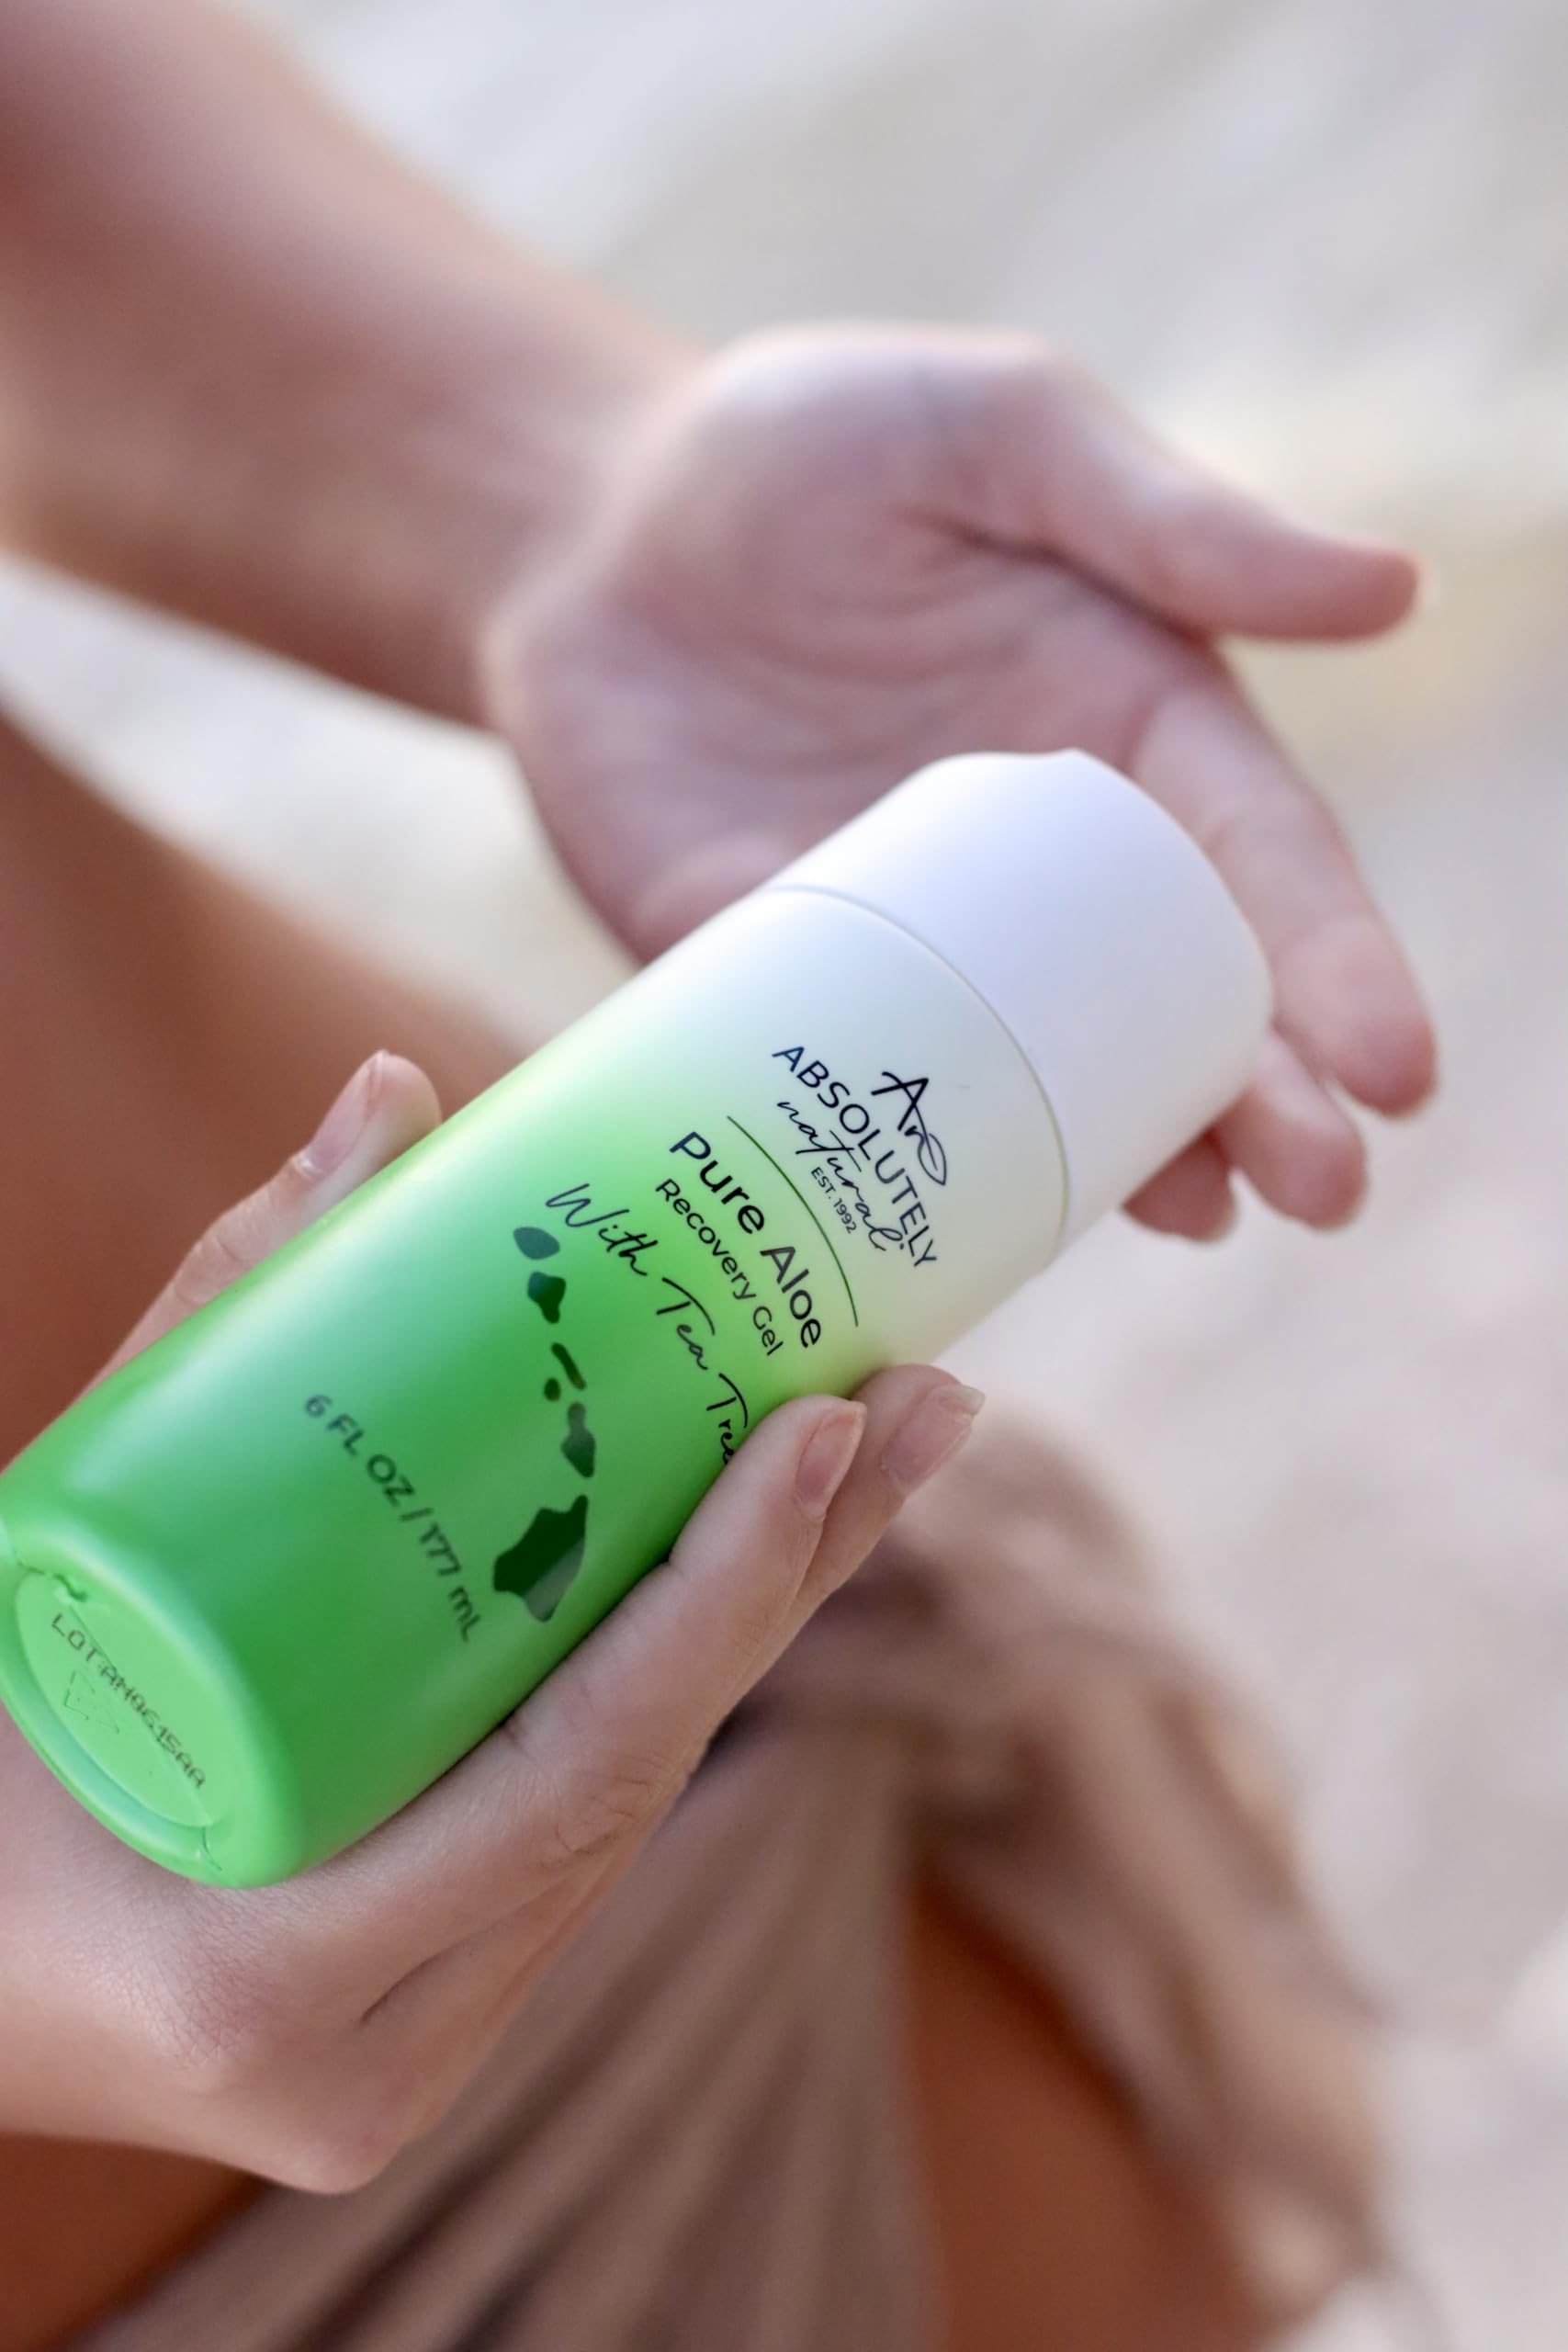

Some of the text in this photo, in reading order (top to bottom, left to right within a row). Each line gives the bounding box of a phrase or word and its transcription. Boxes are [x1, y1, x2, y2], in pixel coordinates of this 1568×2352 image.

[669, 1130, 822, 1350] Pure Aloe
[771, 1045, 938, 1268] ABSOLUTELY
[810, 1166, 858, 1235] EST. 1992
[545, 1182, 660, 1278] With
[655, 1275, 716, 1371] Tea
[655, 1178, 784, 1357] Recovery Gel
[303, 1393, 334, 1419] 6
[325, 1412, 365, 1457] FL
[367, 1453, 416, 1509] OZ
[418, 1521, 462, 1577] 177
[447, 1585, 482, 1644] mL
